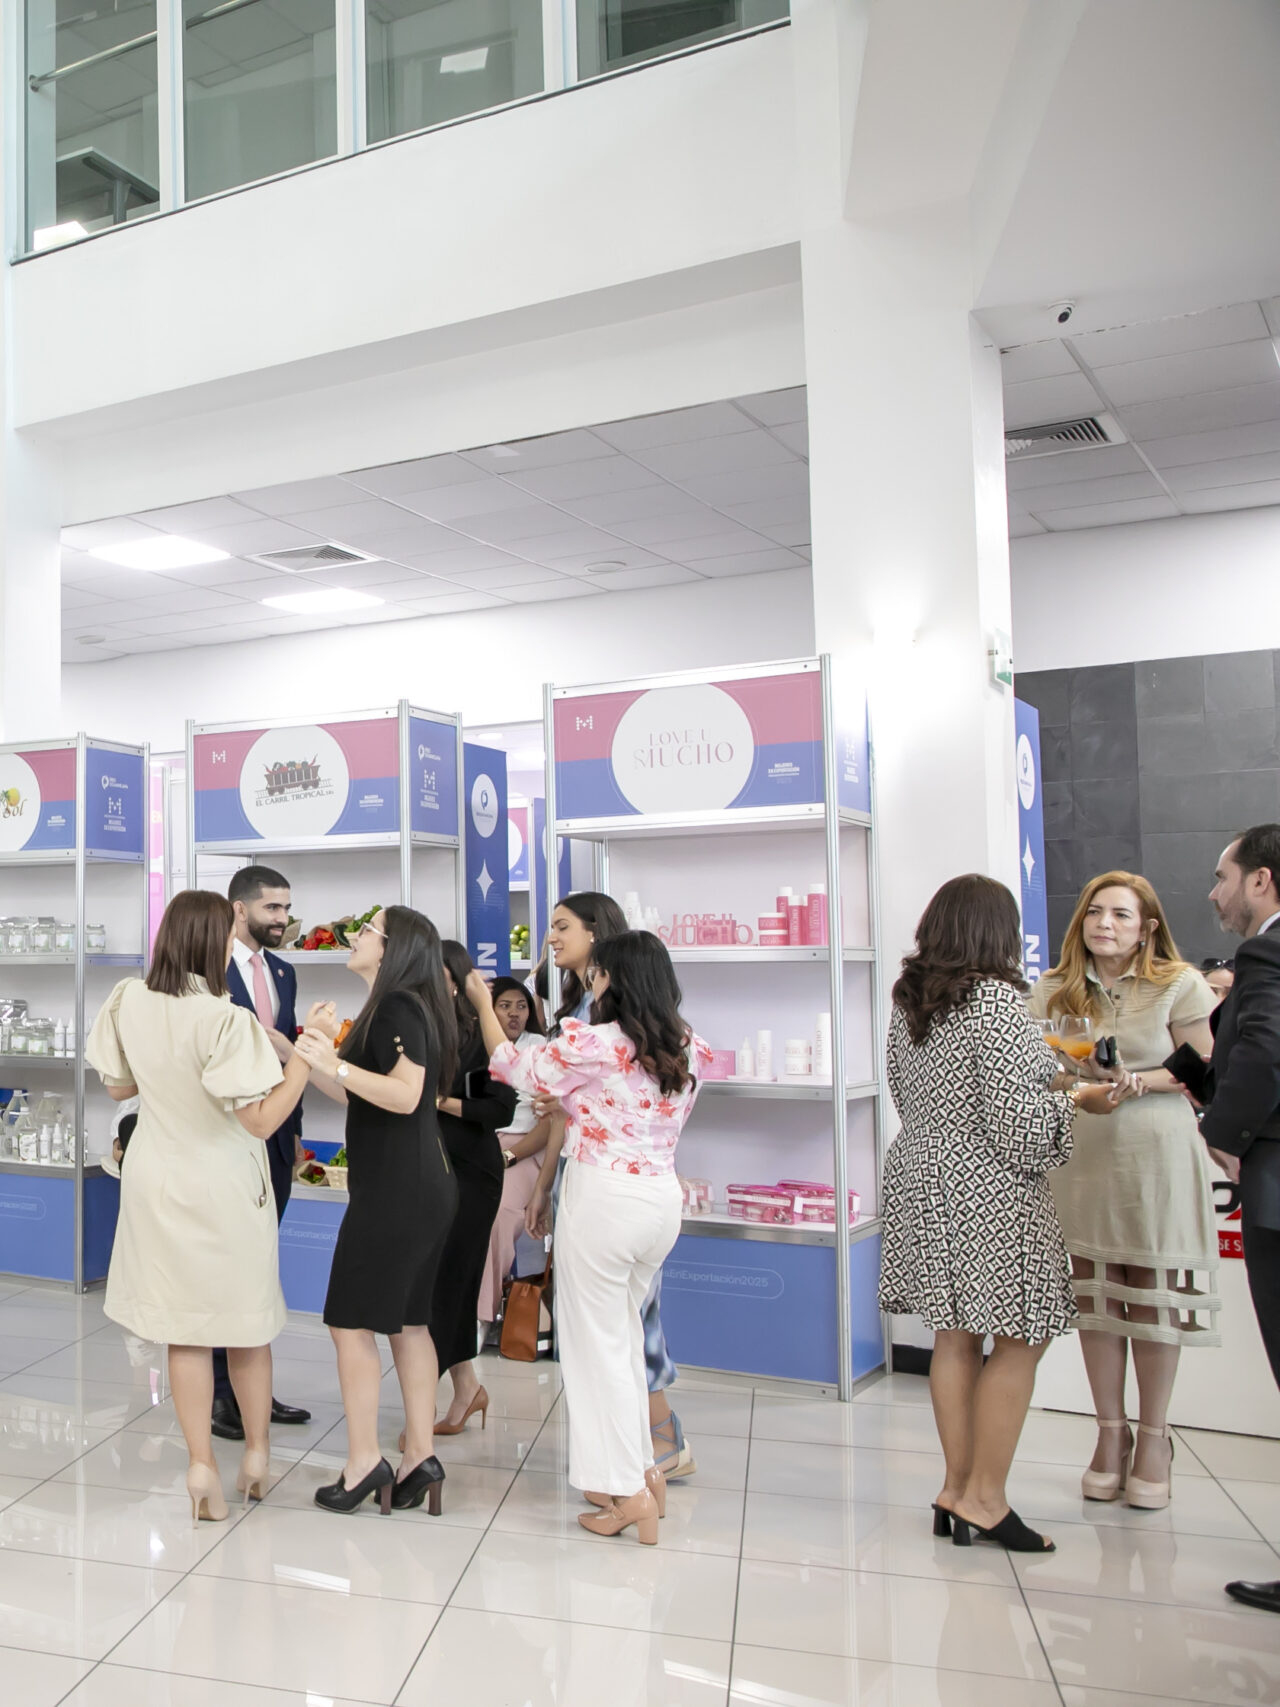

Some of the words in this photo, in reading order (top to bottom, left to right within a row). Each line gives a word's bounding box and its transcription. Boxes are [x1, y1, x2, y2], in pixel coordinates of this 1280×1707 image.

[649, 730, 694, 746] LOVE
[631, 741, 734, 770] MUCHO
[265, 796, 289, 806] CARRIL
[292, 789, 325, 801] TROPICAL
[2, 798, 28, 819] Sol
